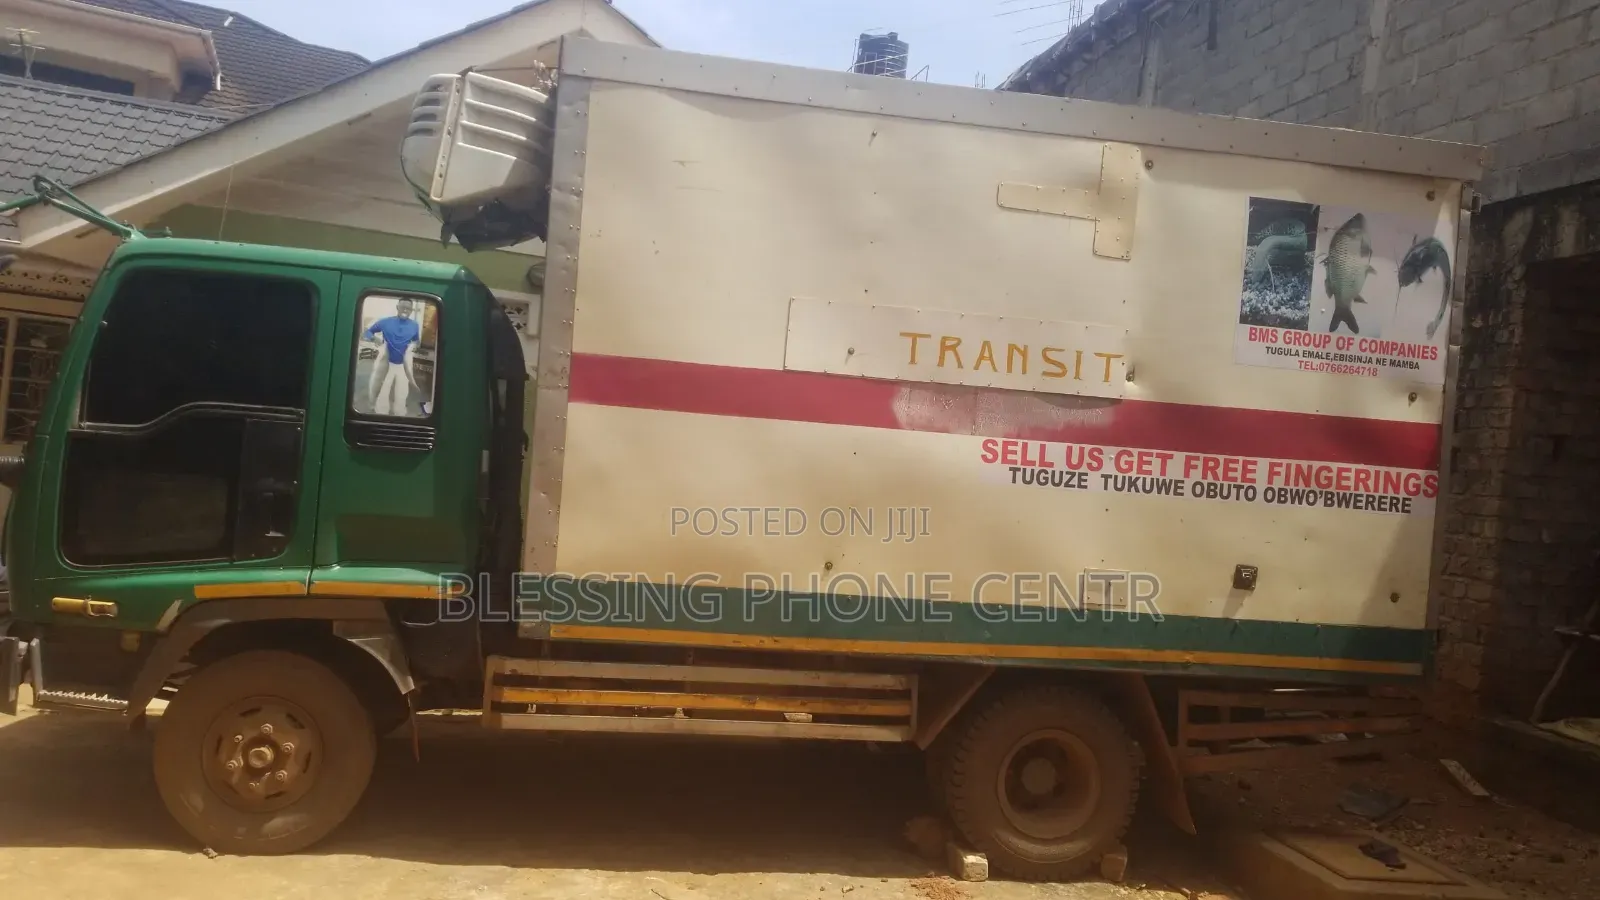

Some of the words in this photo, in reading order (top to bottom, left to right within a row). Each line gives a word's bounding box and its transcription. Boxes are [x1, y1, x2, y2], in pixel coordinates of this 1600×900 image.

[899, 331, 1125, 383] TRANSIT
[1248, 326, 1279, 344] BMS
[1282, 331, 1331, 350] GROUP
[1335, 336, 1355, 350] OF
[1358, 338, 1438, 360] COMPANIES
[1265, 346, 1300, 358] TUGULA
[1375, 358, 1388, 367] NE
[1389, 360, 1420, 371] MAMBA
[1298, 360, 1378, 376] TEL:0766264718
[980, 438, 1055, 468] SELL
[1065, 444, 1104, 471] US
[1113, 449, 1174, 476] GET
[1183, 455, 1257, 484] FREE
[1267, 461, 1439, 499] FINGERINGS
[1008, 466, 1089, 490] TUGUZE
[1100, 473, 1185, 497] TUKUWE
[1191, 480, 1257, 502] OBUTO
